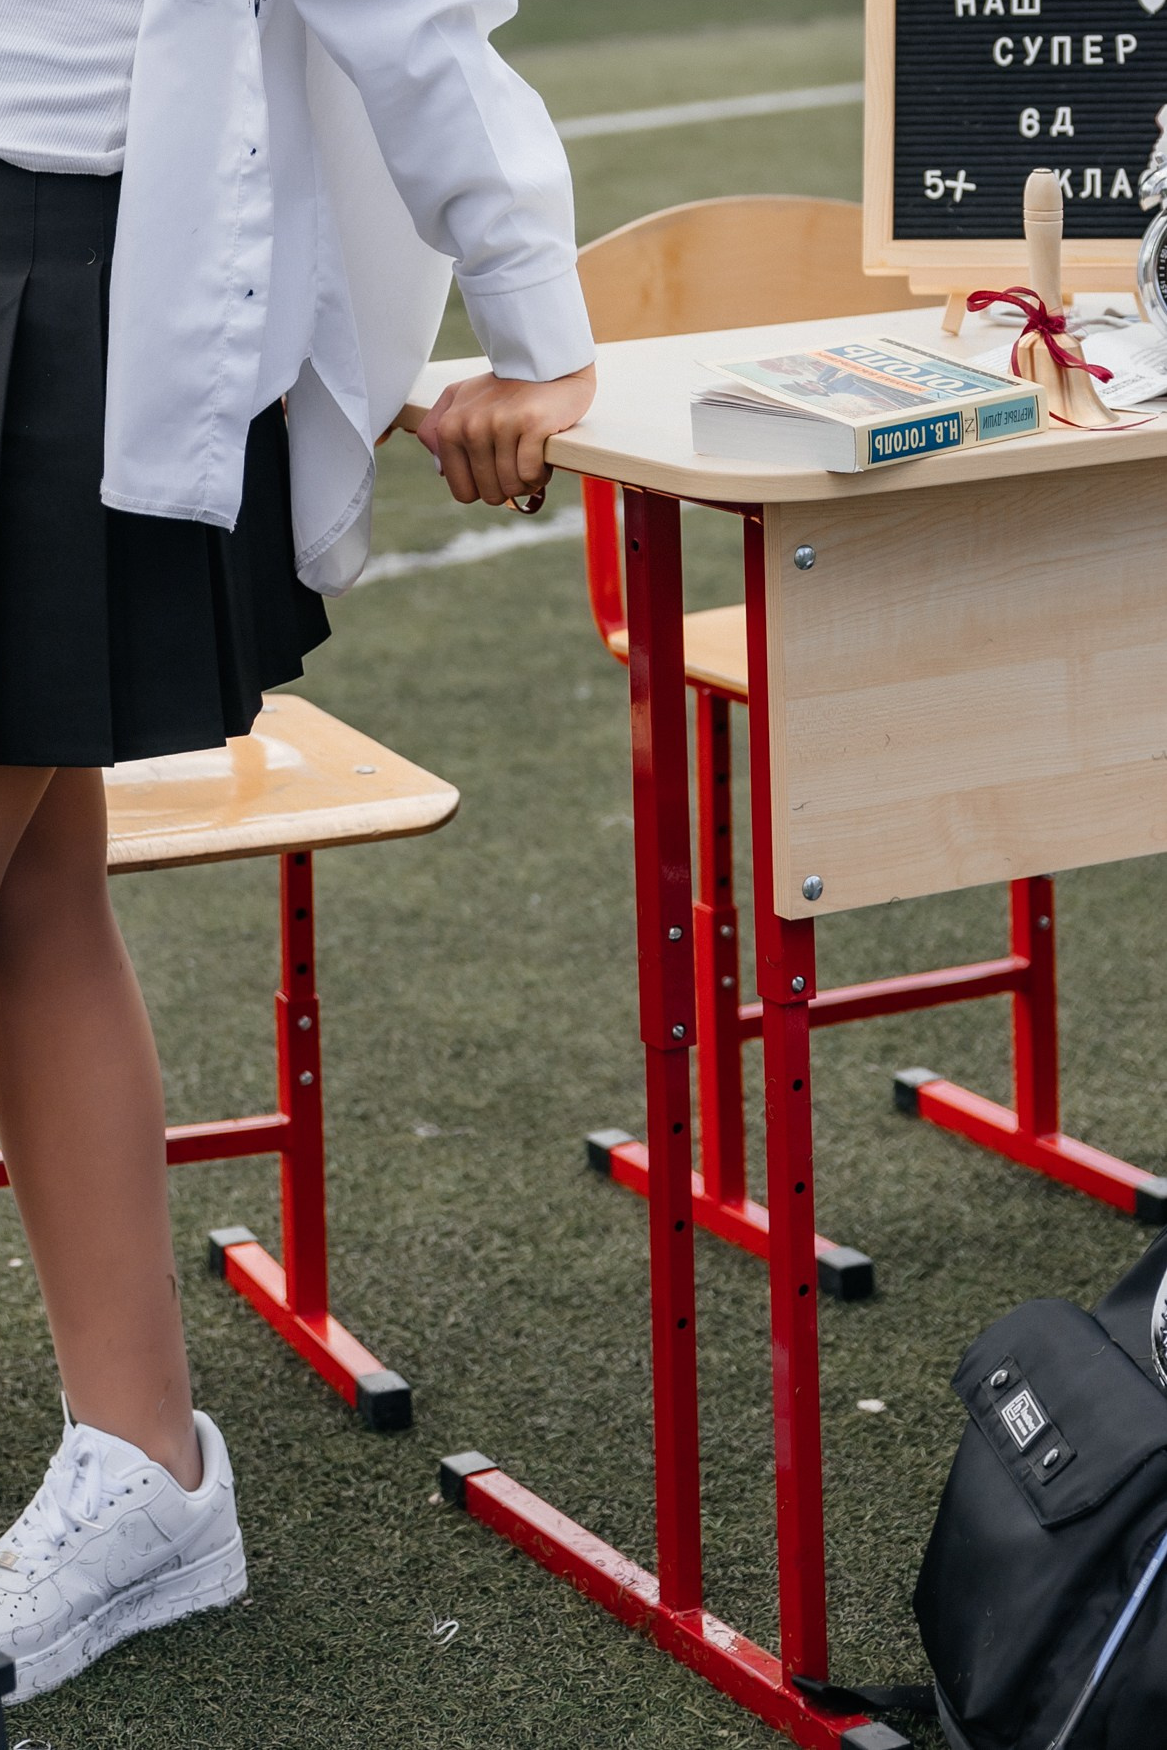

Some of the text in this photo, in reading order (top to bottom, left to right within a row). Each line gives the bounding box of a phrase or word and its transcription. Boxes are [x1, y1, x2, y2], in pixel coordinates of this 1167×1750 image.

[993, 34, 1137, 66] СУПЕР
[1019, 106, 1074, 138] 6Д
[924, 167, 1151, 202] 5+ КЛА
[842, 345, 986, 397] ГОГОЛЬ
[982, 411, 1003, 430] ДУШИ
[1004, 406, 1034, 424] МЕРТВЫЕ
[874, 426, 926, 455] ГОГОЛЬ
[929, 418, 958, 444] Н.В.
